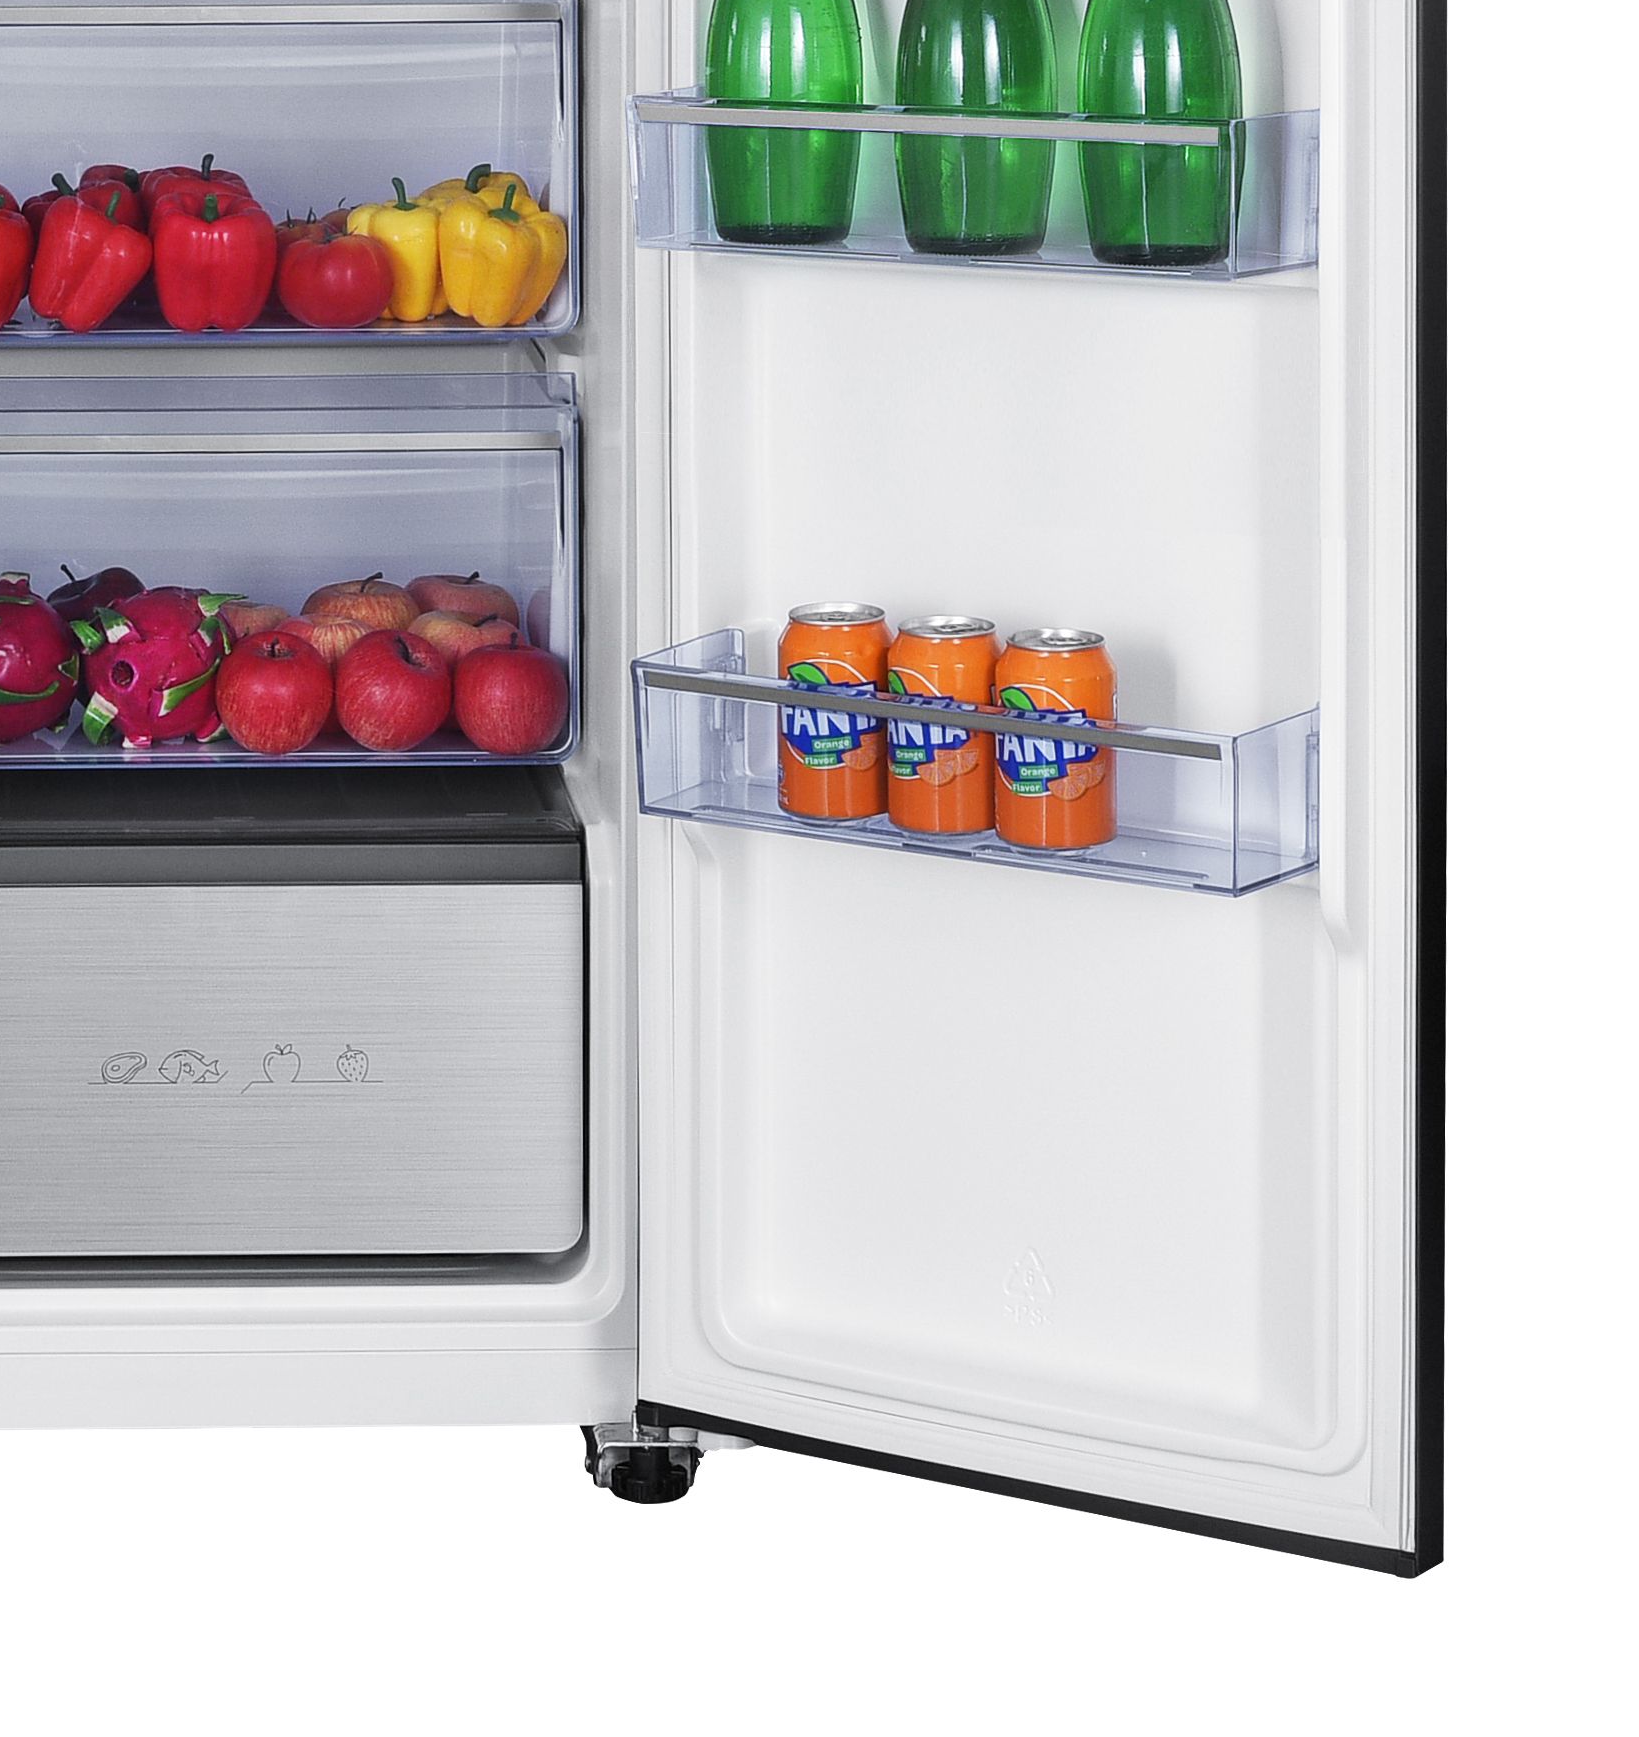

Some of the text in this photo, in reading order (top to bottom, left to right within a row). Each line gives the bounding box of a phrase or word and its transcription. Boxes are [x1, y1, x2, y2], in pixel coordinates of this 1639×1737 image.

[888, 709, 968, 746] ANTA
[814, 738, 850, 750] Orange
[805, 755, 835, 766] Flavor
[895, 750, 924, 760] Orange
[1020, 766, 1056, 777] Orange
[1012, 783, 1041, 792] Flavor
